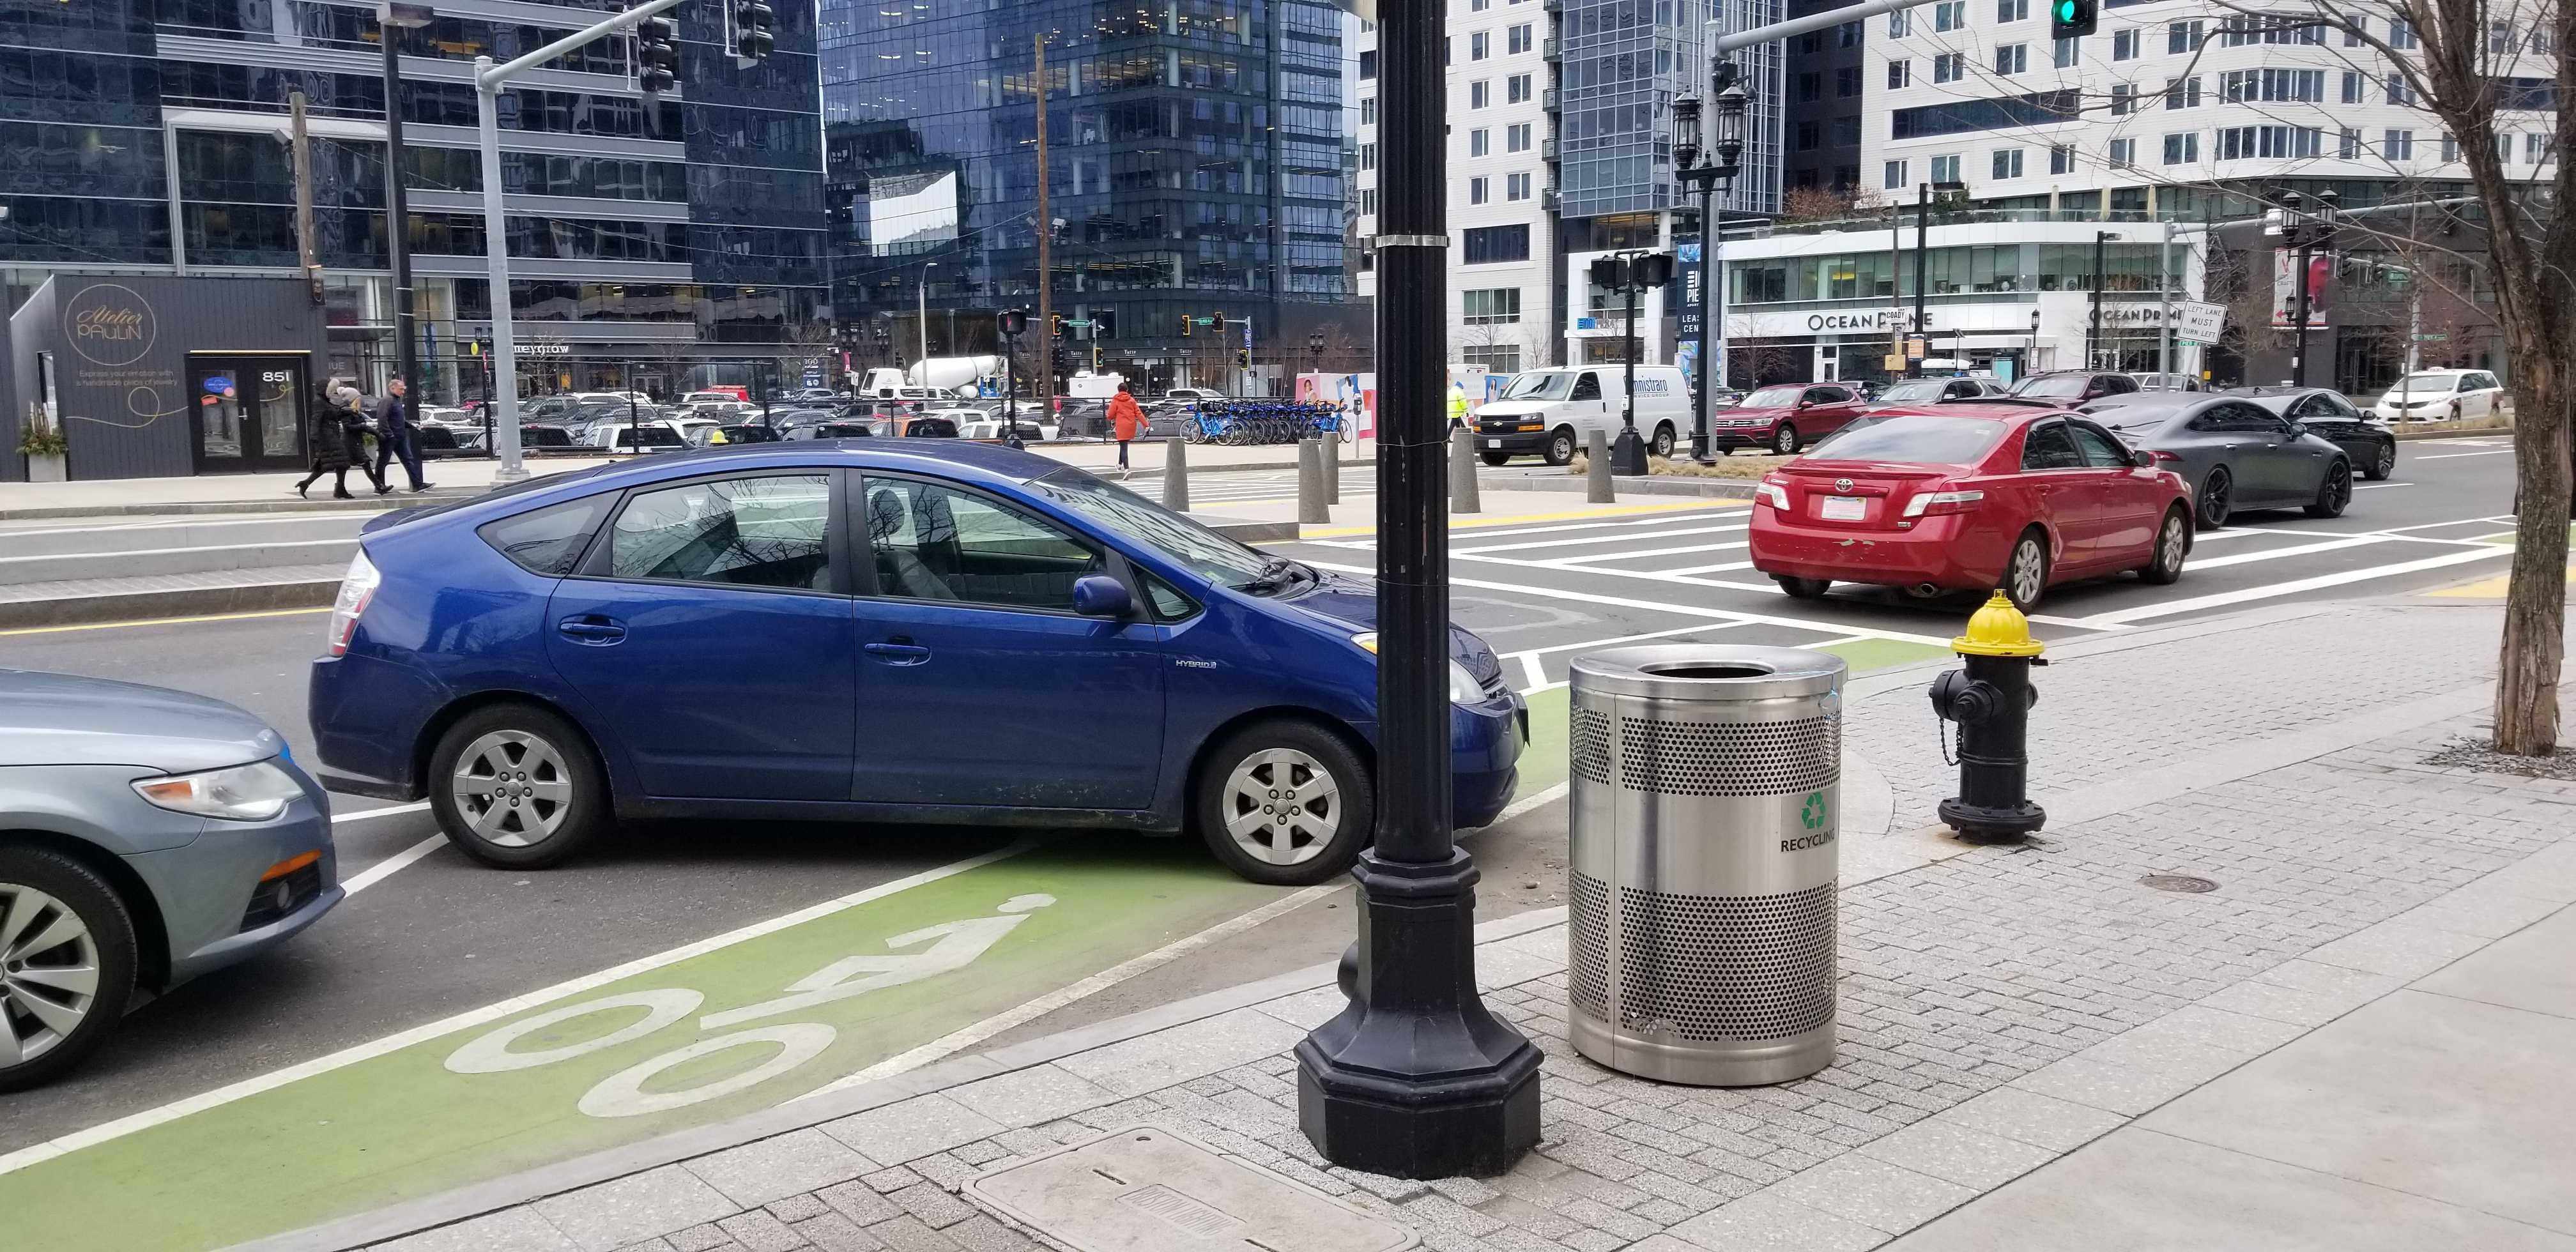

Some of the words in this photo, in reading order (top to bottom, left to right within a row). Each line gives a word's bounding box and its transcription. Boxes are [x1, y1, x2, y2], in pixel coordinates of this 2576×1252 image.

[1687, 288, 1699, 302] PIE
[77, 305, 142, 324] Atelier
[2143, 309, 2184, 321] PRME
[1807, 314, 1873, 331] OCEAN
[2191, 317, 2213, 326] MUST
[513, 345, 569, 355] neygrow
[262, 371, 289, 382] 851
[1623, 375, 1668, 392] mnistraro
[1176, 660, 1210, 668] HYBRID
[1781, 827, 1835, 853] RECYCLING
